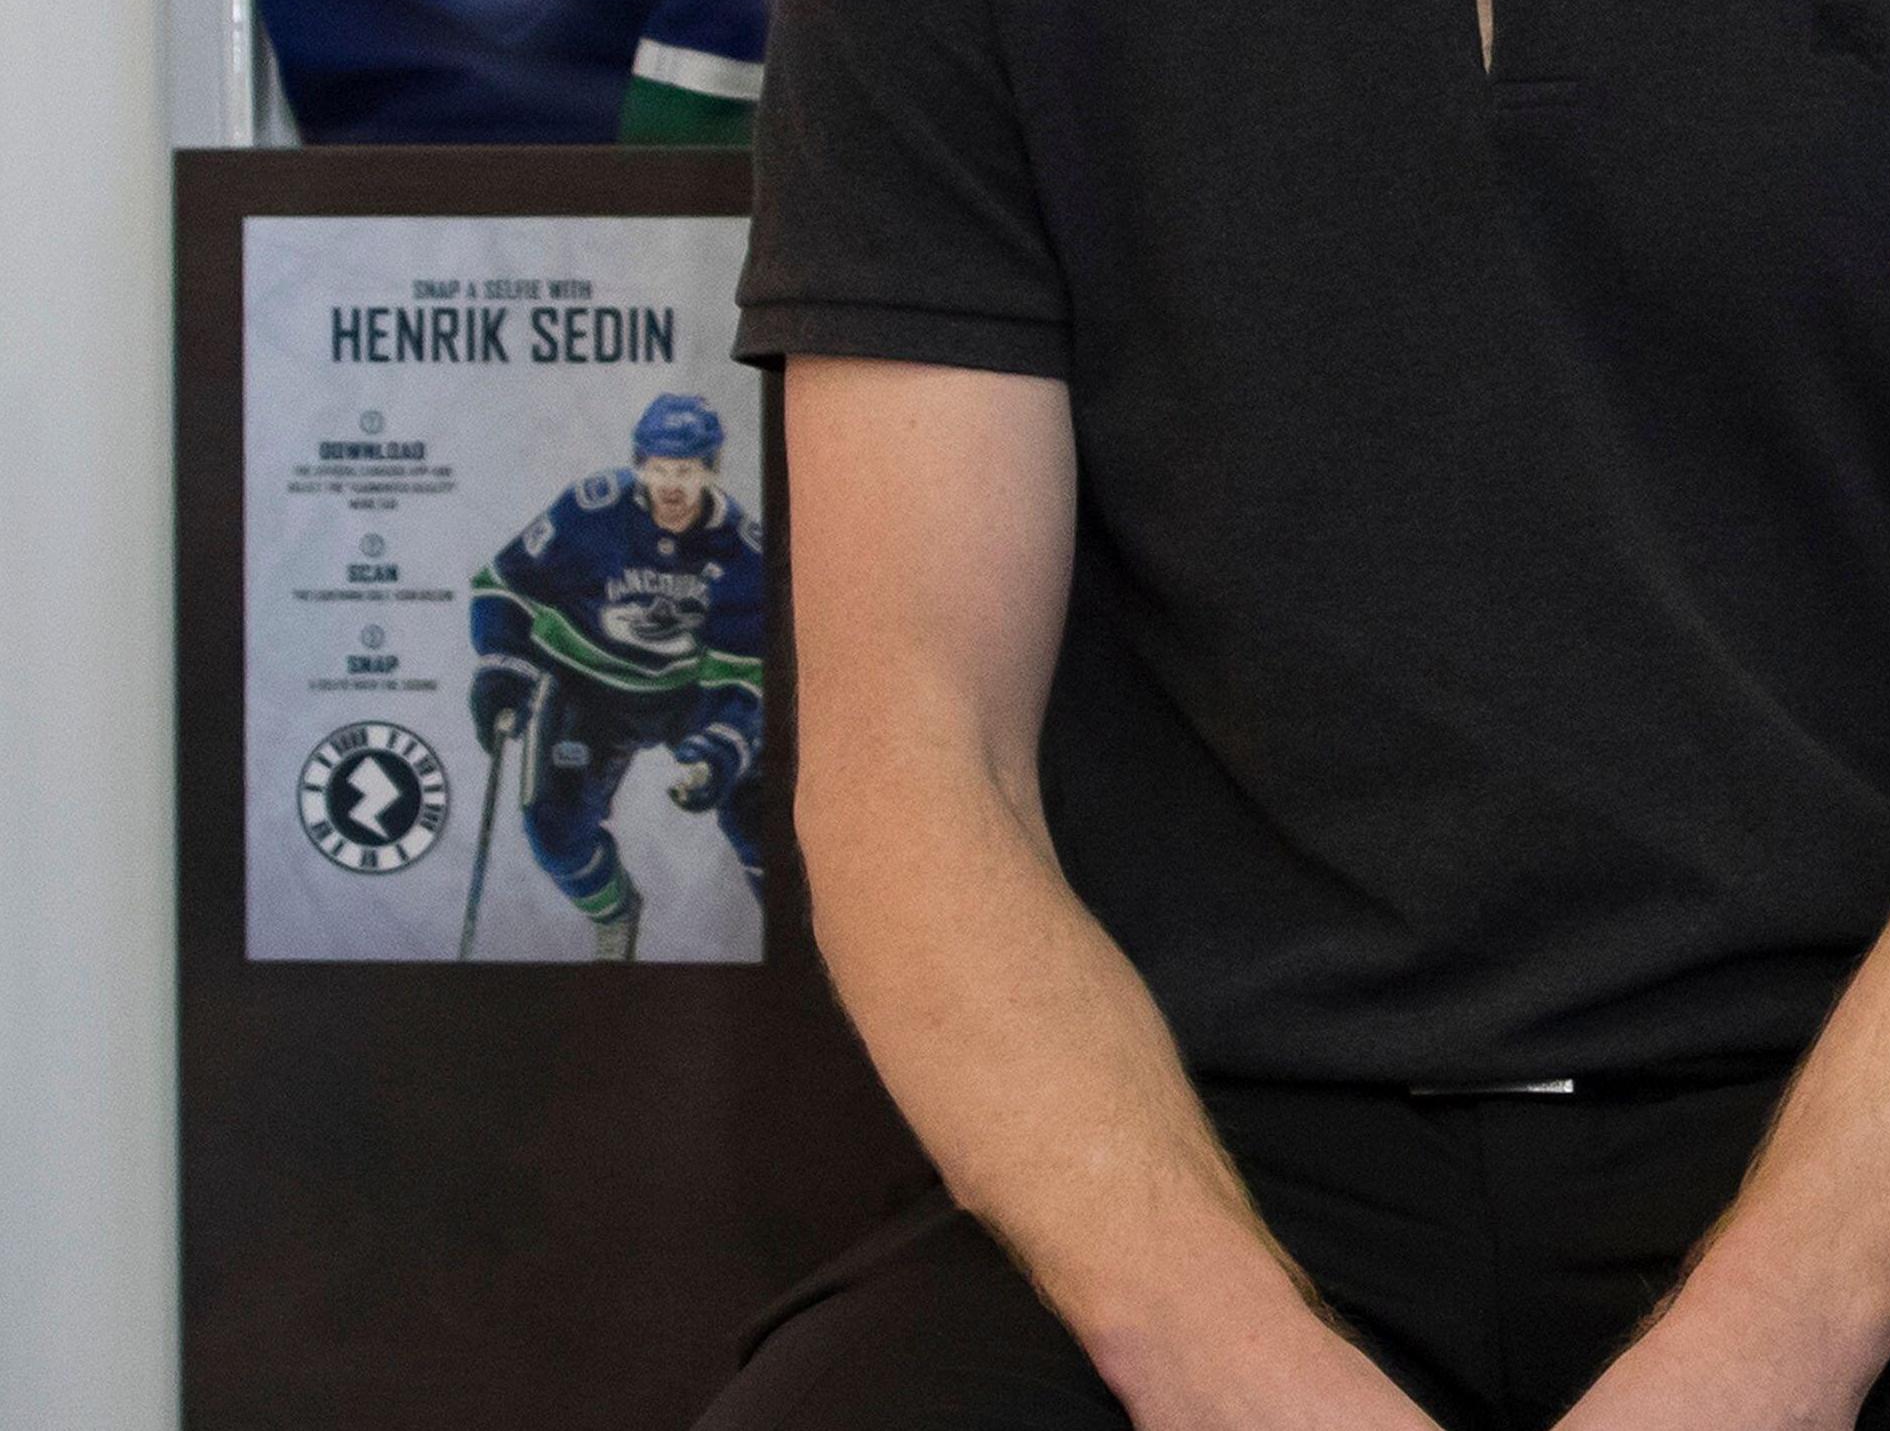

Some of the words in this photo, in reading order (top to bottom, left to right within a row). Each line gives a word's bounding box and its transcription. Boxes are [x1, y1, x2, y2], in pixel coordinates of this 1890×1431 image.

[412, 279, 461, 300] SNAP
[466, 280, 477, 300] A
[483, 279, 541, 300] SELFIE
[547, 279, 593, 300] WITH
[330, 306, 509, 364] HENRIK
[530, 306, 675, 364] SEDIN
[319, 441, 425, 460] DOWNLOAD
[347, 564, 399, 583] SCAN
[347, 654, 399, 674] SNAP
